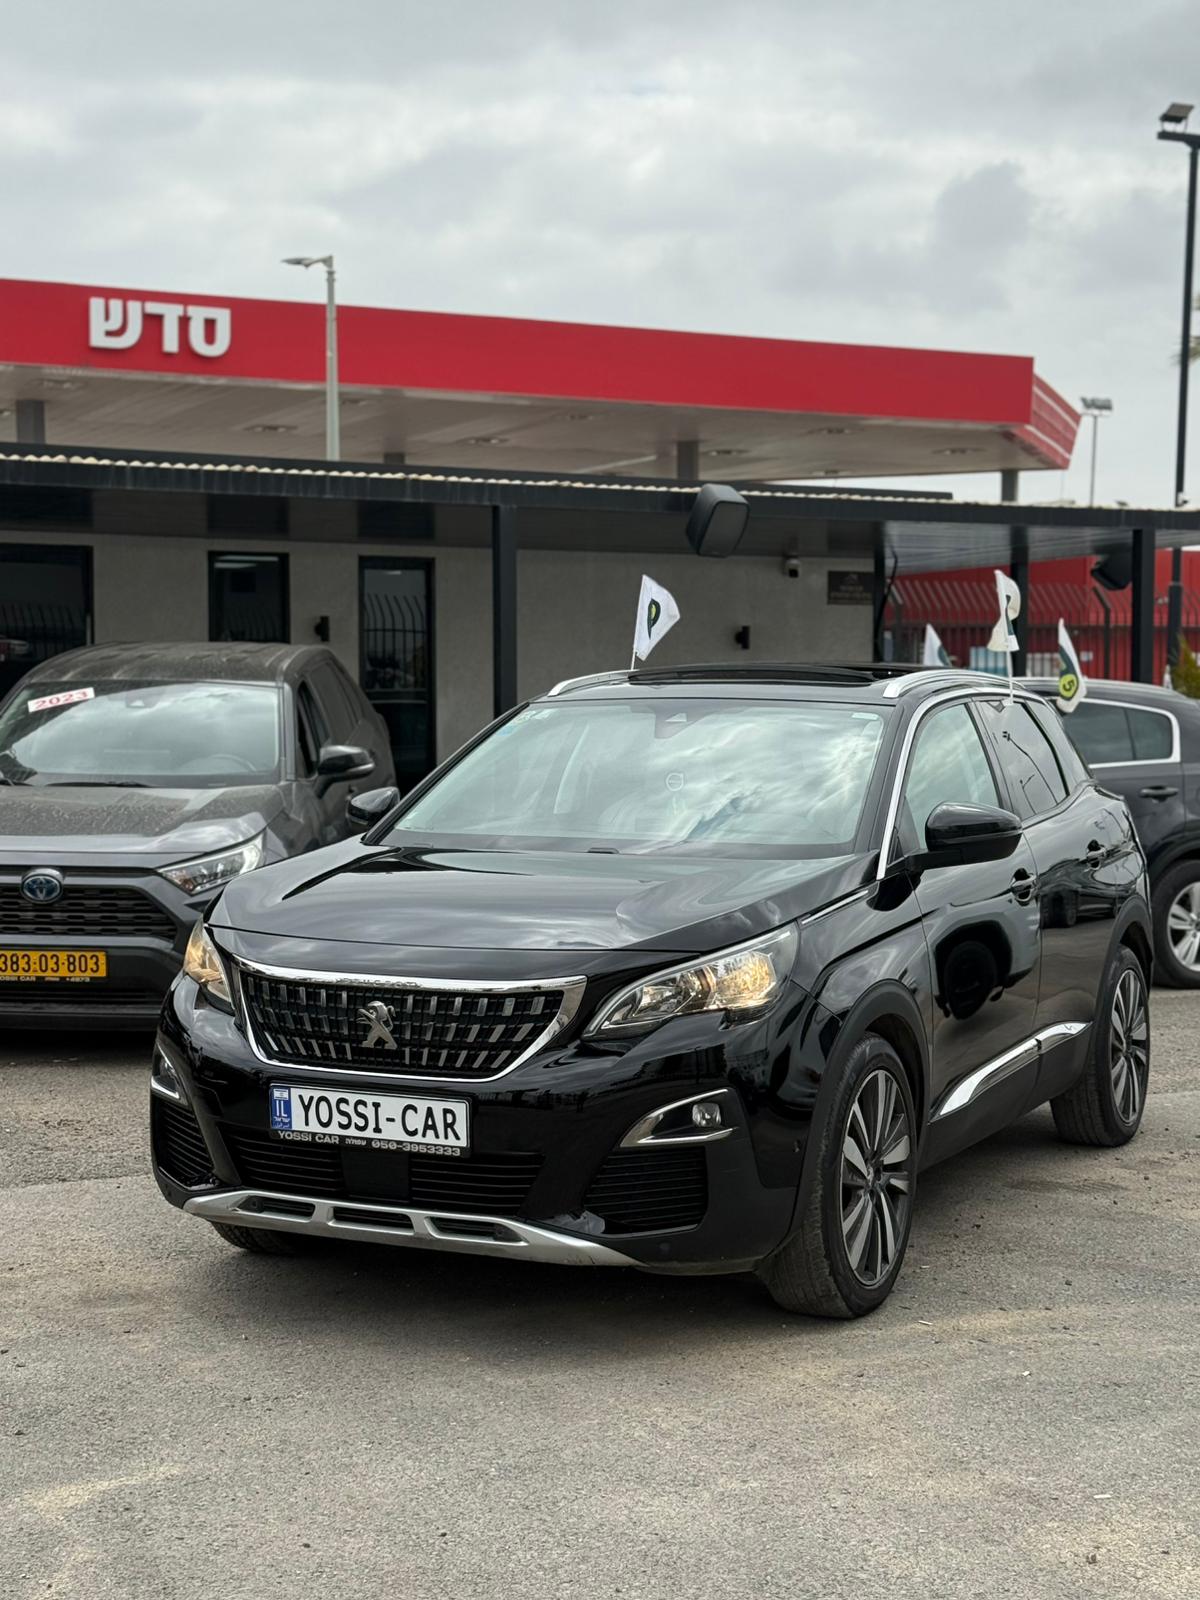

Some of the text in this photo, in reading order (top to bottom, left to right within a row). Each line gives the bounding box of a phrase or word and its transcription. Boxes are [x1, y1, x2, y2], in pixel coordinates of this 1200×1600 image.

[89, 297, 231, 358] סדש
[34, 691, 87, 709] 2023
[276, 1100, 288, 1117] IL
[298, 1094, 461, 1140] YOSSI-CAR
[278, 1130, 312, 1142] YOSSI
[315, 1133, 340, 1145] CAR
[371, 1139, 461, 1157] 050-3953333
